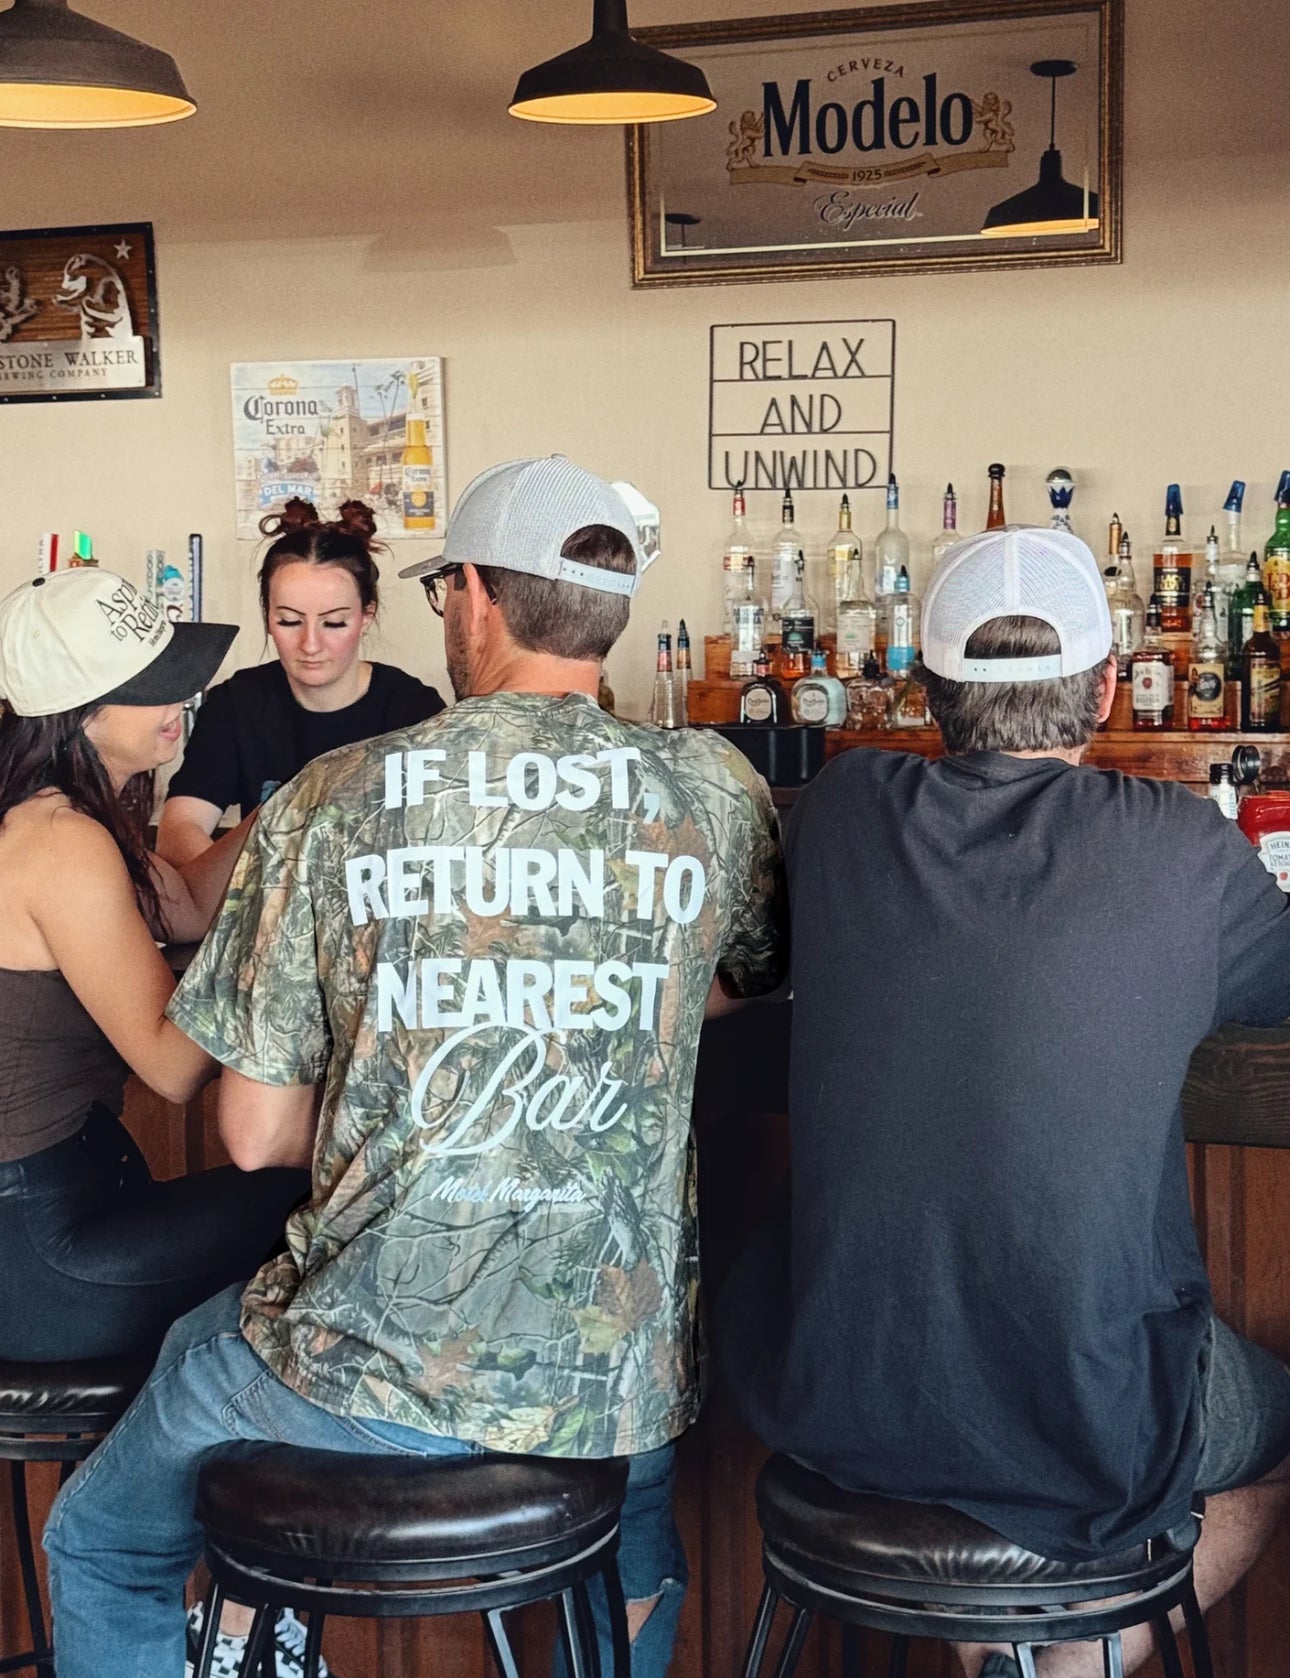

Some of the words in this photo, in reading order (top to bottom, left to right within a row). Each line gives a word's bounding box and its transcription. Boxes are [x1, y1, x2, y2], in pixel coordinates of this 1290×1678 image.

[827, 57, 905, 83] CERVEZA
[762, 72, 973, 157] Modelo
[852, 168, 882, 182] 1925
[813, 191, 921, 232] Especial
[49, 368, 108, 379] COMPANY
[63, 350, 138, 367] WALKER
[739, 337, 866, 381] RELAX
[243, 395, 319, 424] Corona
[265, 419, 306, 435] Extra
[760, 393, 842, 434] AND
[724, 448, 877, 489] UNWIND
[263, 485, 287, 496] DEL
[287, 484, 313, 495] MAR
[111, 625, 128, 642] to
[385, 749, 446, 810] IF
[468, 746, 661, 824] LOST,
[345, 846, 605, 926] RETURN
[625, 849, 706, 924] TO
[376, 957, 670, 1032] NEAREST
[411, 1020, 628, 1157] Bar
[489, 1176, 587, 1213] Margarita
